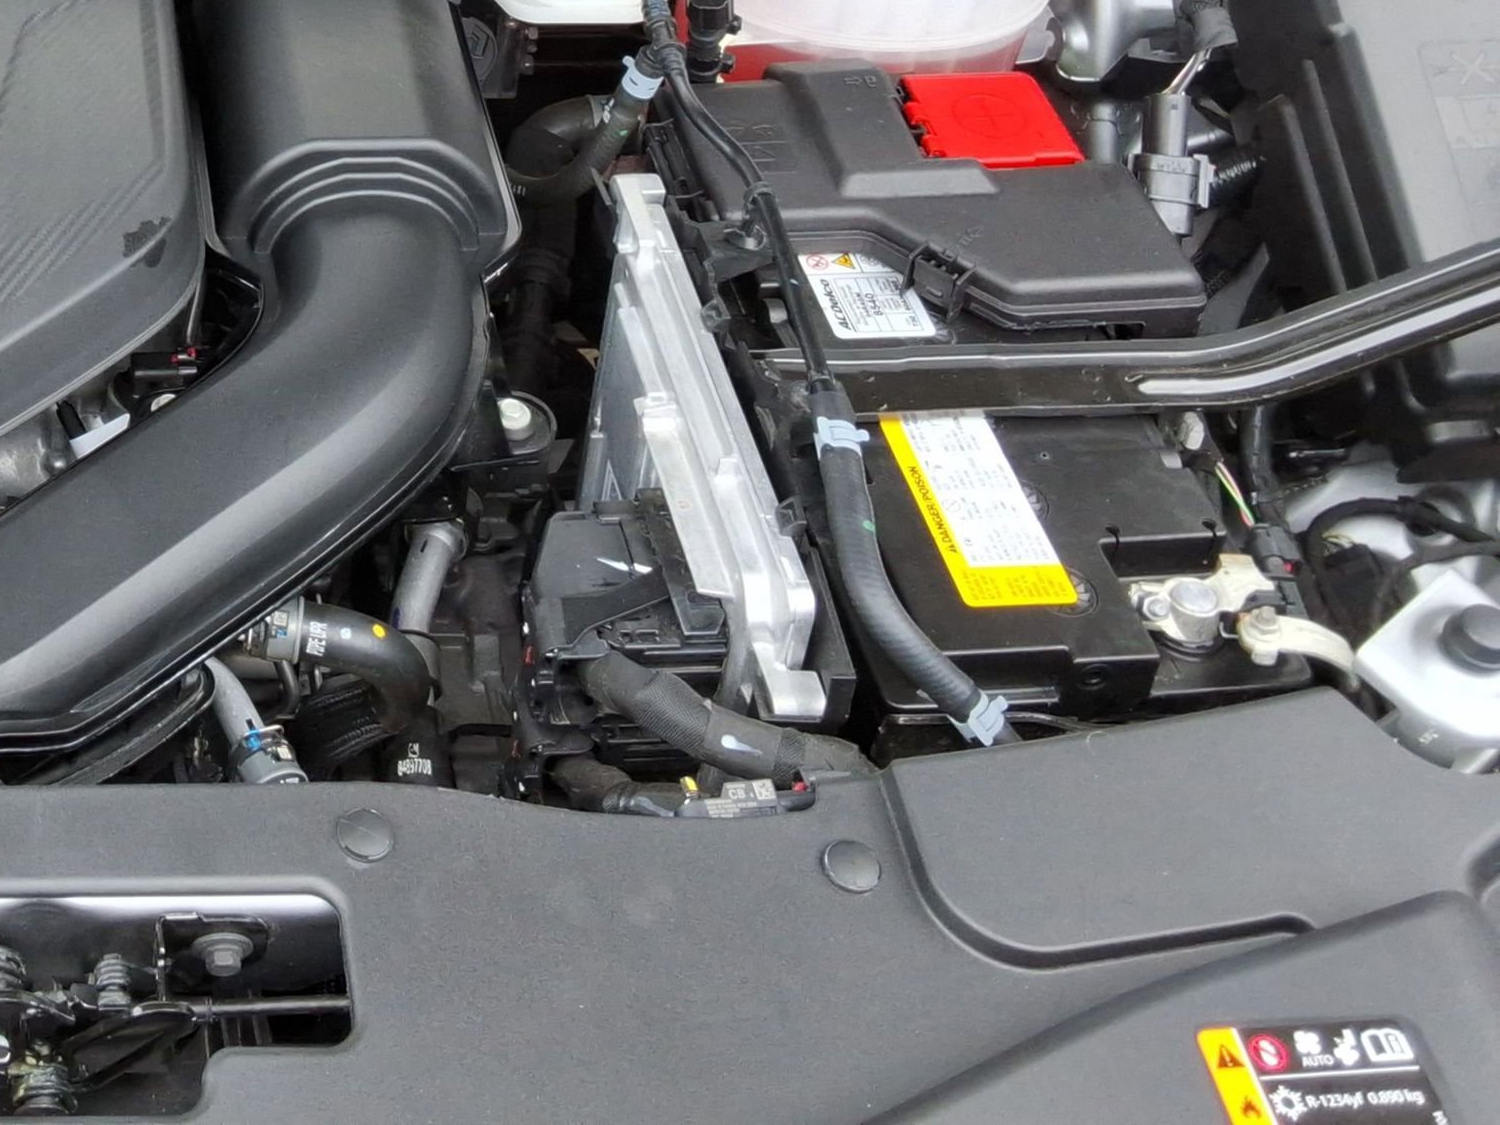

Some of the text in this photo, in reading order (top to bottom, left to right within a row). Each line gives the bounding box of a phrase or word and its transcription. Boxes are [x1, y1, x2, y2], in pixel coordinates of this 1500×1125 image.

[820, 279, 852, 331] ACDelco
[1302, 1054, 1334, 1067] AUTO
[1305, 1090, 1364, 1110] R-1234yf
